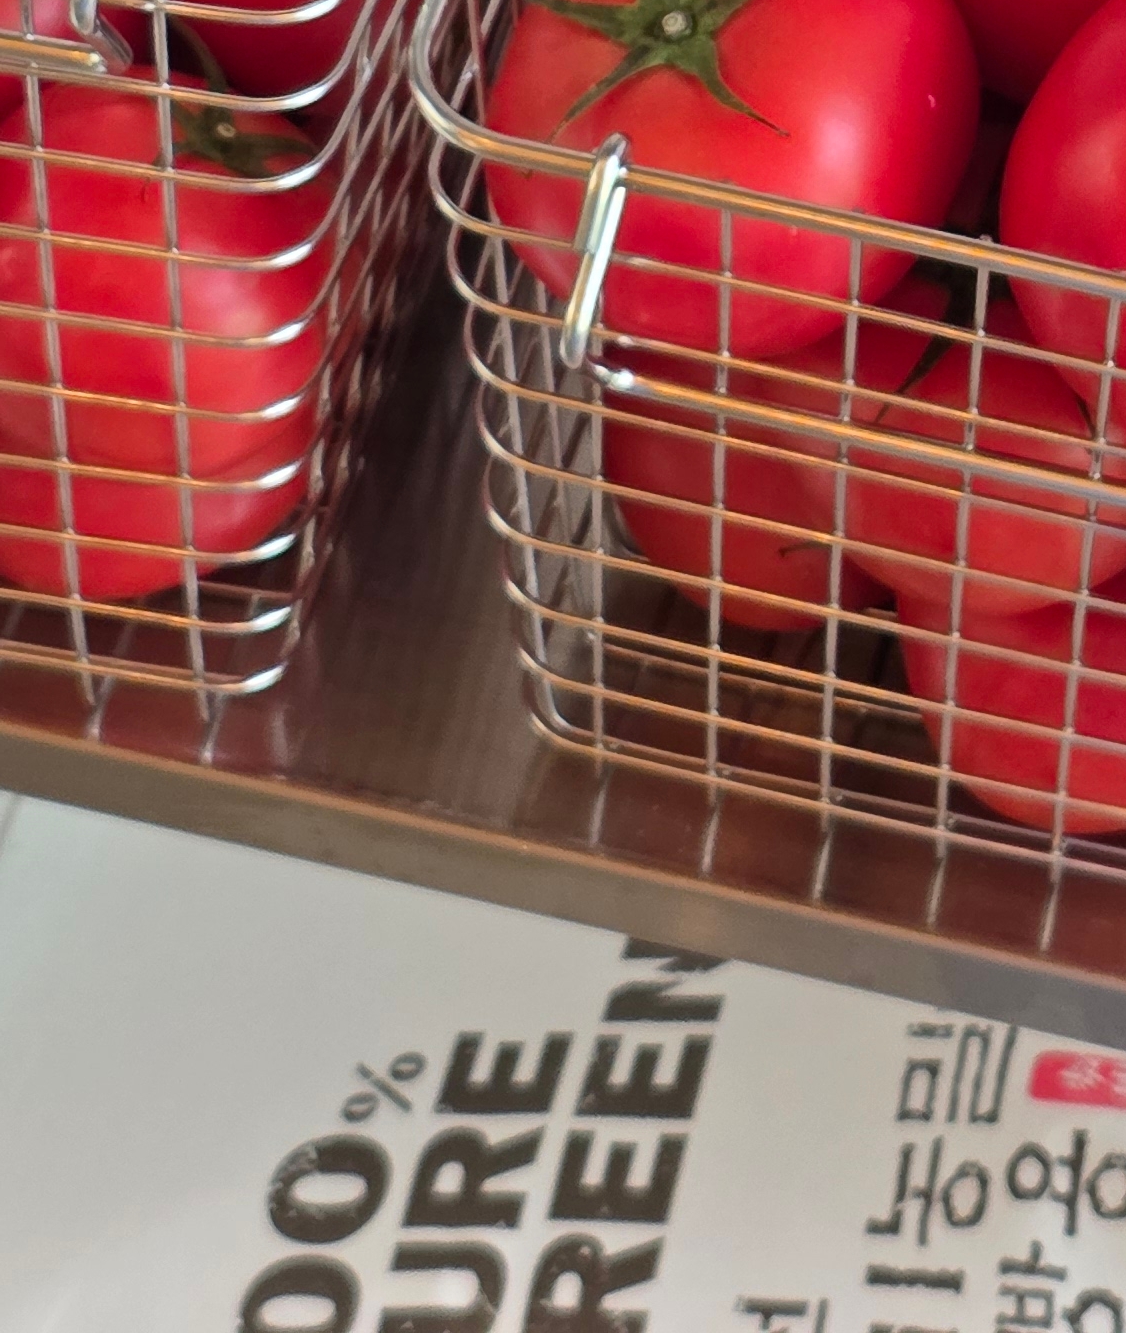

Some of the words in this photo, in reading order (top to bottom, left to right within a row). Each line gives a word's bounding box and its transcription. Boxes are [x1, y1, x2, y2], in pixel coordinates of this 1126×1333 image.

[237, 1052, 426, 1333] 00%
[377, 1031, 575, 1333] URE
[523, 936, 735, 1333] REEN
[864, 1023, 1020, 1333] 농밀
